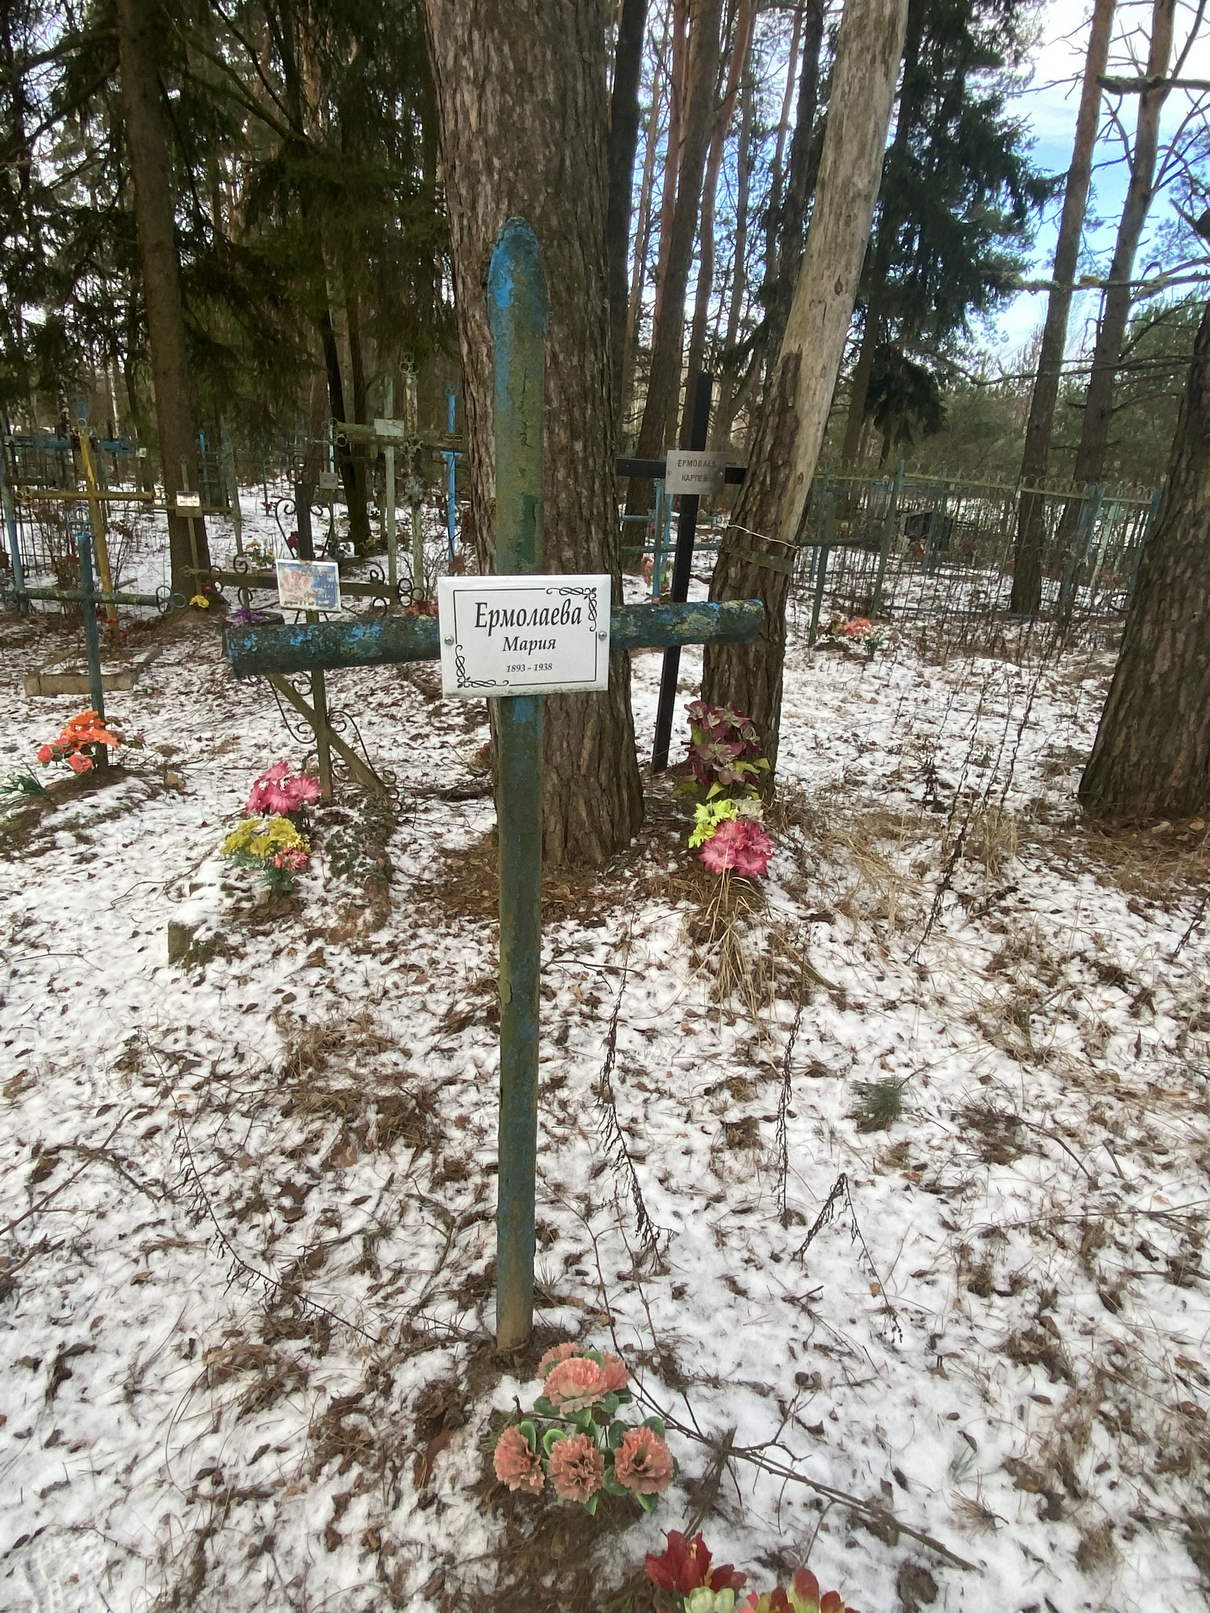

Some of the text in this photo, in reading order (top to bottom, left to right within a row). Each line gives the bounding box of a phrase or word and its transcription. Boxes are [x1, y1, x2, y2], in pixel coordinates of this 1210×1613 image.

[474, 599, 582, 636] Ермолаева
[502, 636, 557, 655] Мария
[506, 664, 526, 673] 1893
[534, 663, 553, 672] 1938
